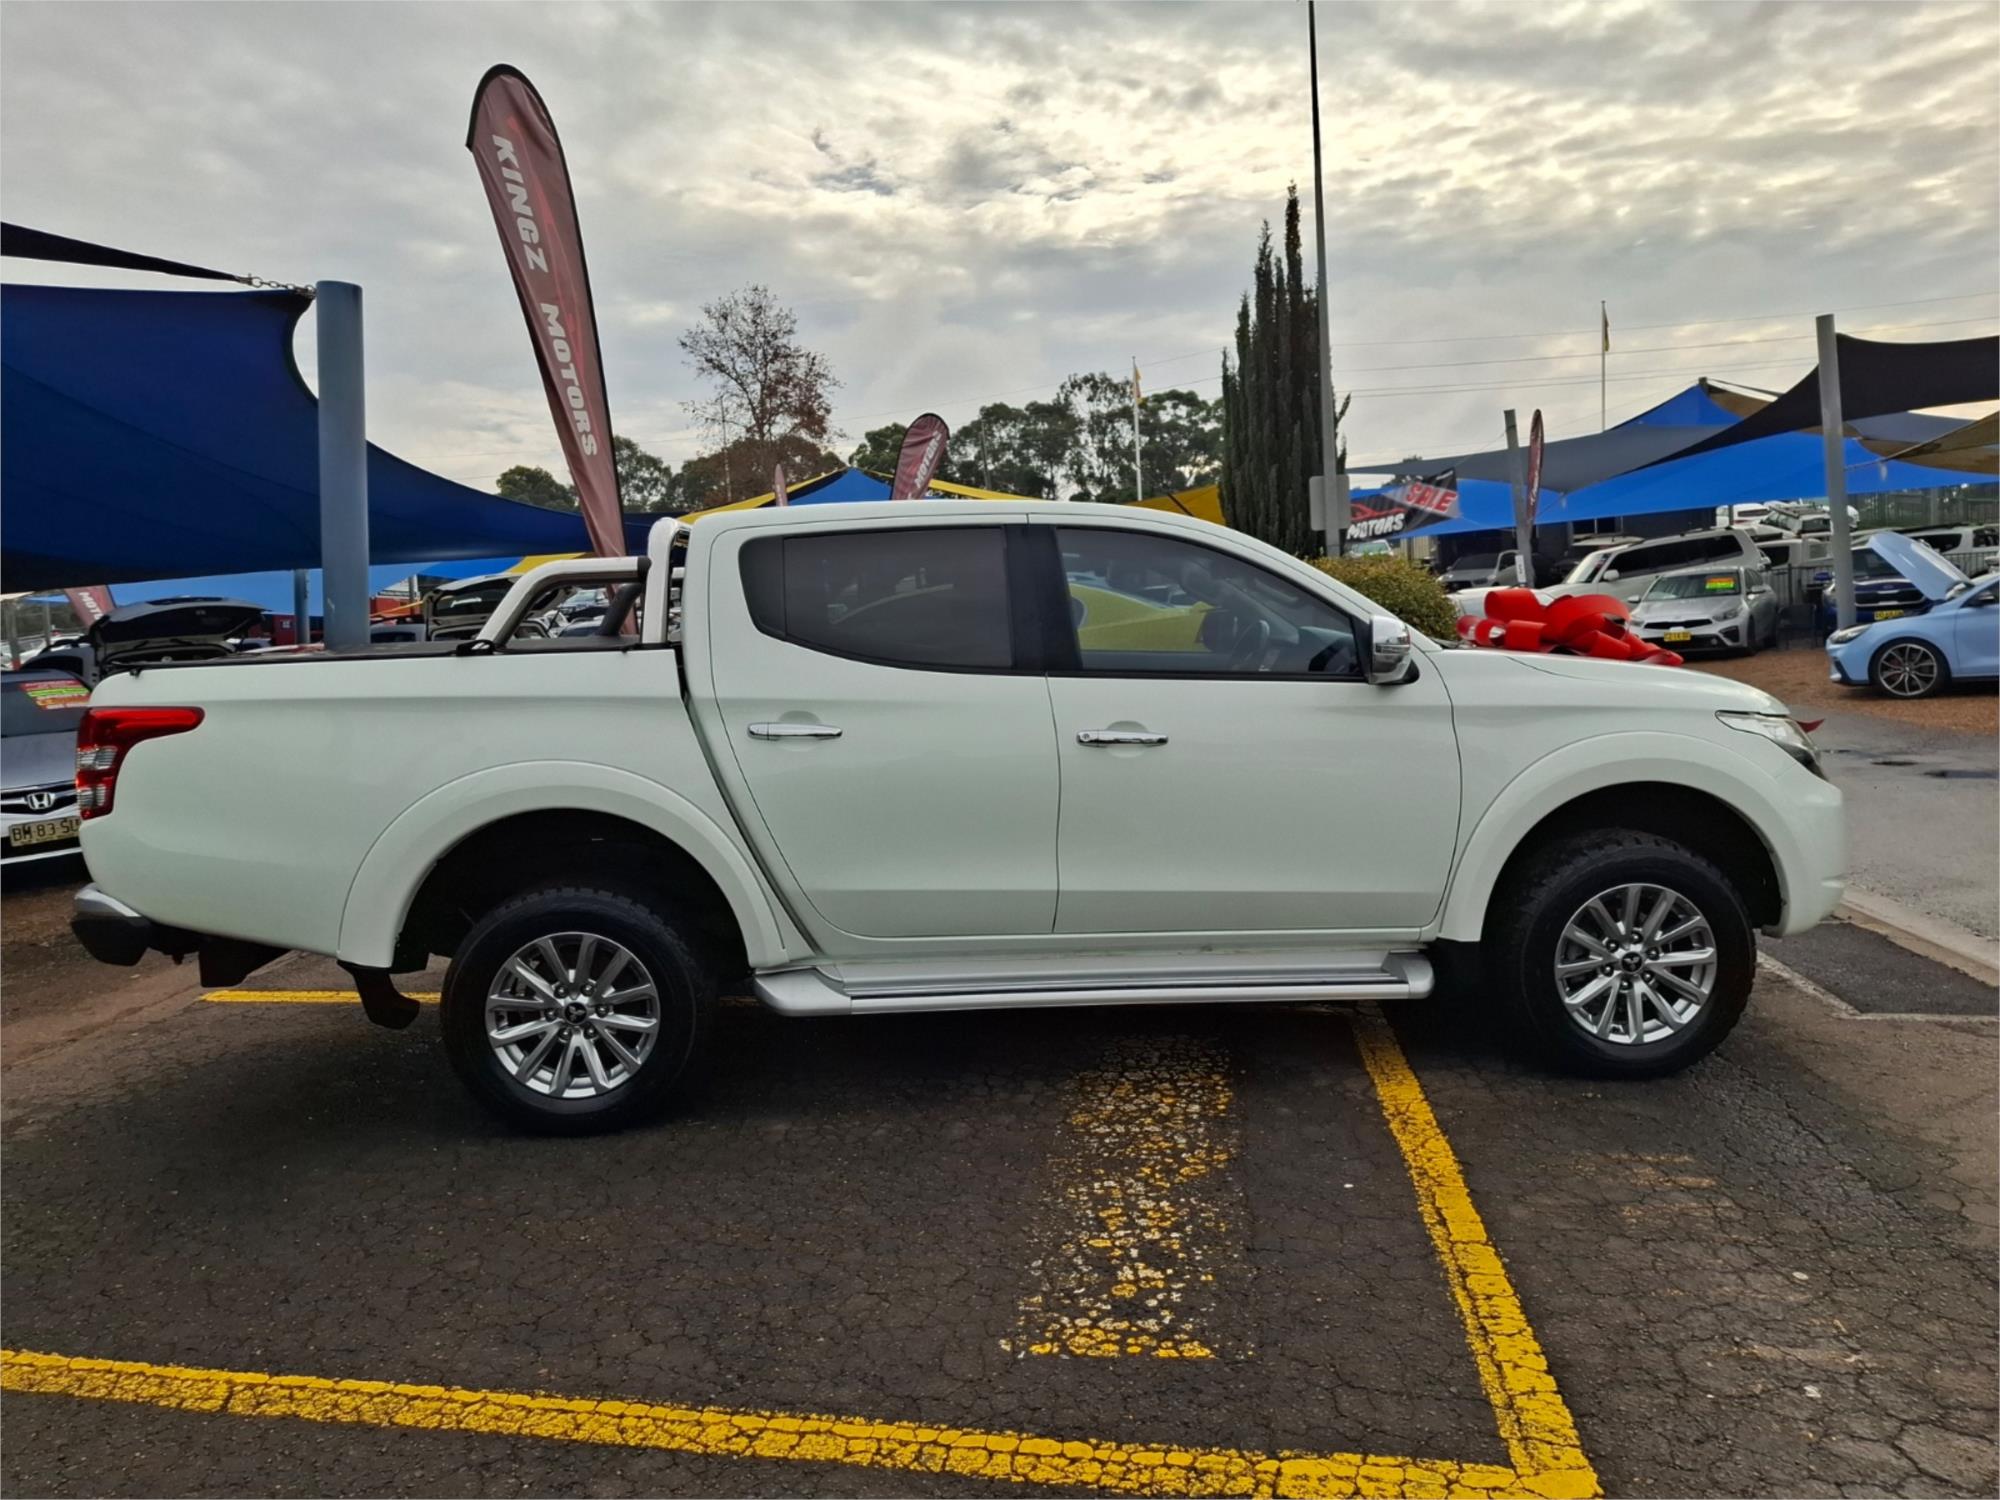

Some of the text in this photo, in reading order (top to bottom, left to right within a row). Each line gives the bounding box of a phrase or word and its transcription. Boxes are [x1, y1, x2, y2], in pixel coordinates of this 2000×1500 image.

[492, 133, 598, 458] KINGZ MOTORS
[1405, 481, 1458, 513] SALE
[1346, 513, 1405, 540] MOTORS
